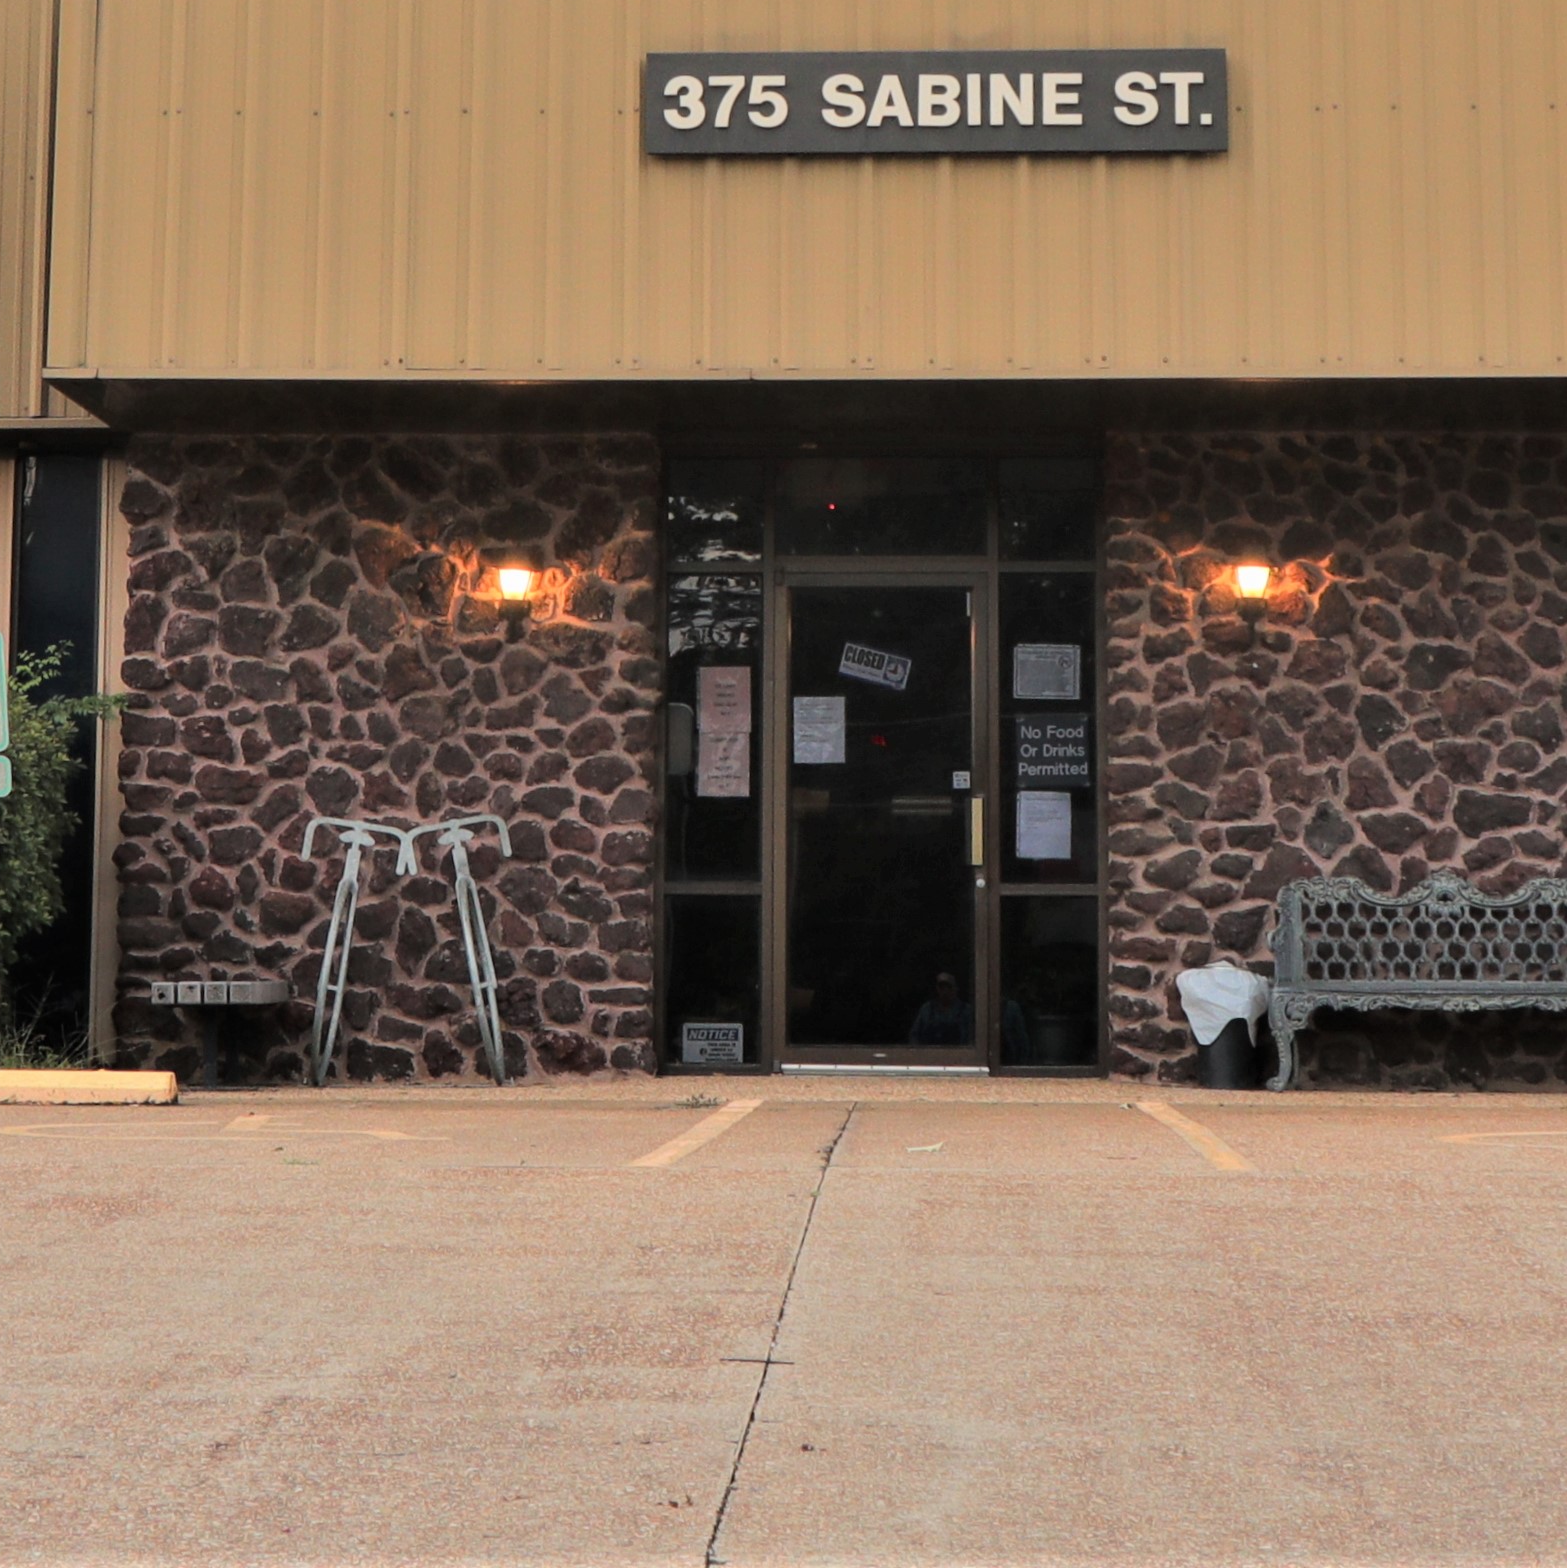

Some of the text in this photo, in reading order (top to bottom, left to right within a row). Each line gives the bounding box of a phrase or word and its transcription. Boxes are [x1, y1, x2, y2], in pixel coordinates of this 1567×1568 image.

[663, 71, 1213, 130] 375 SABINE ST.
[844, 645, 886, 671] CLOSED
[1020, 725, 1084, 739] No Food
[1020, 743, 1085, 757] Or Drinks
[1018, 762, 1088, 776] Permitted
[688, 1029, 737, 1040] NOTICE
